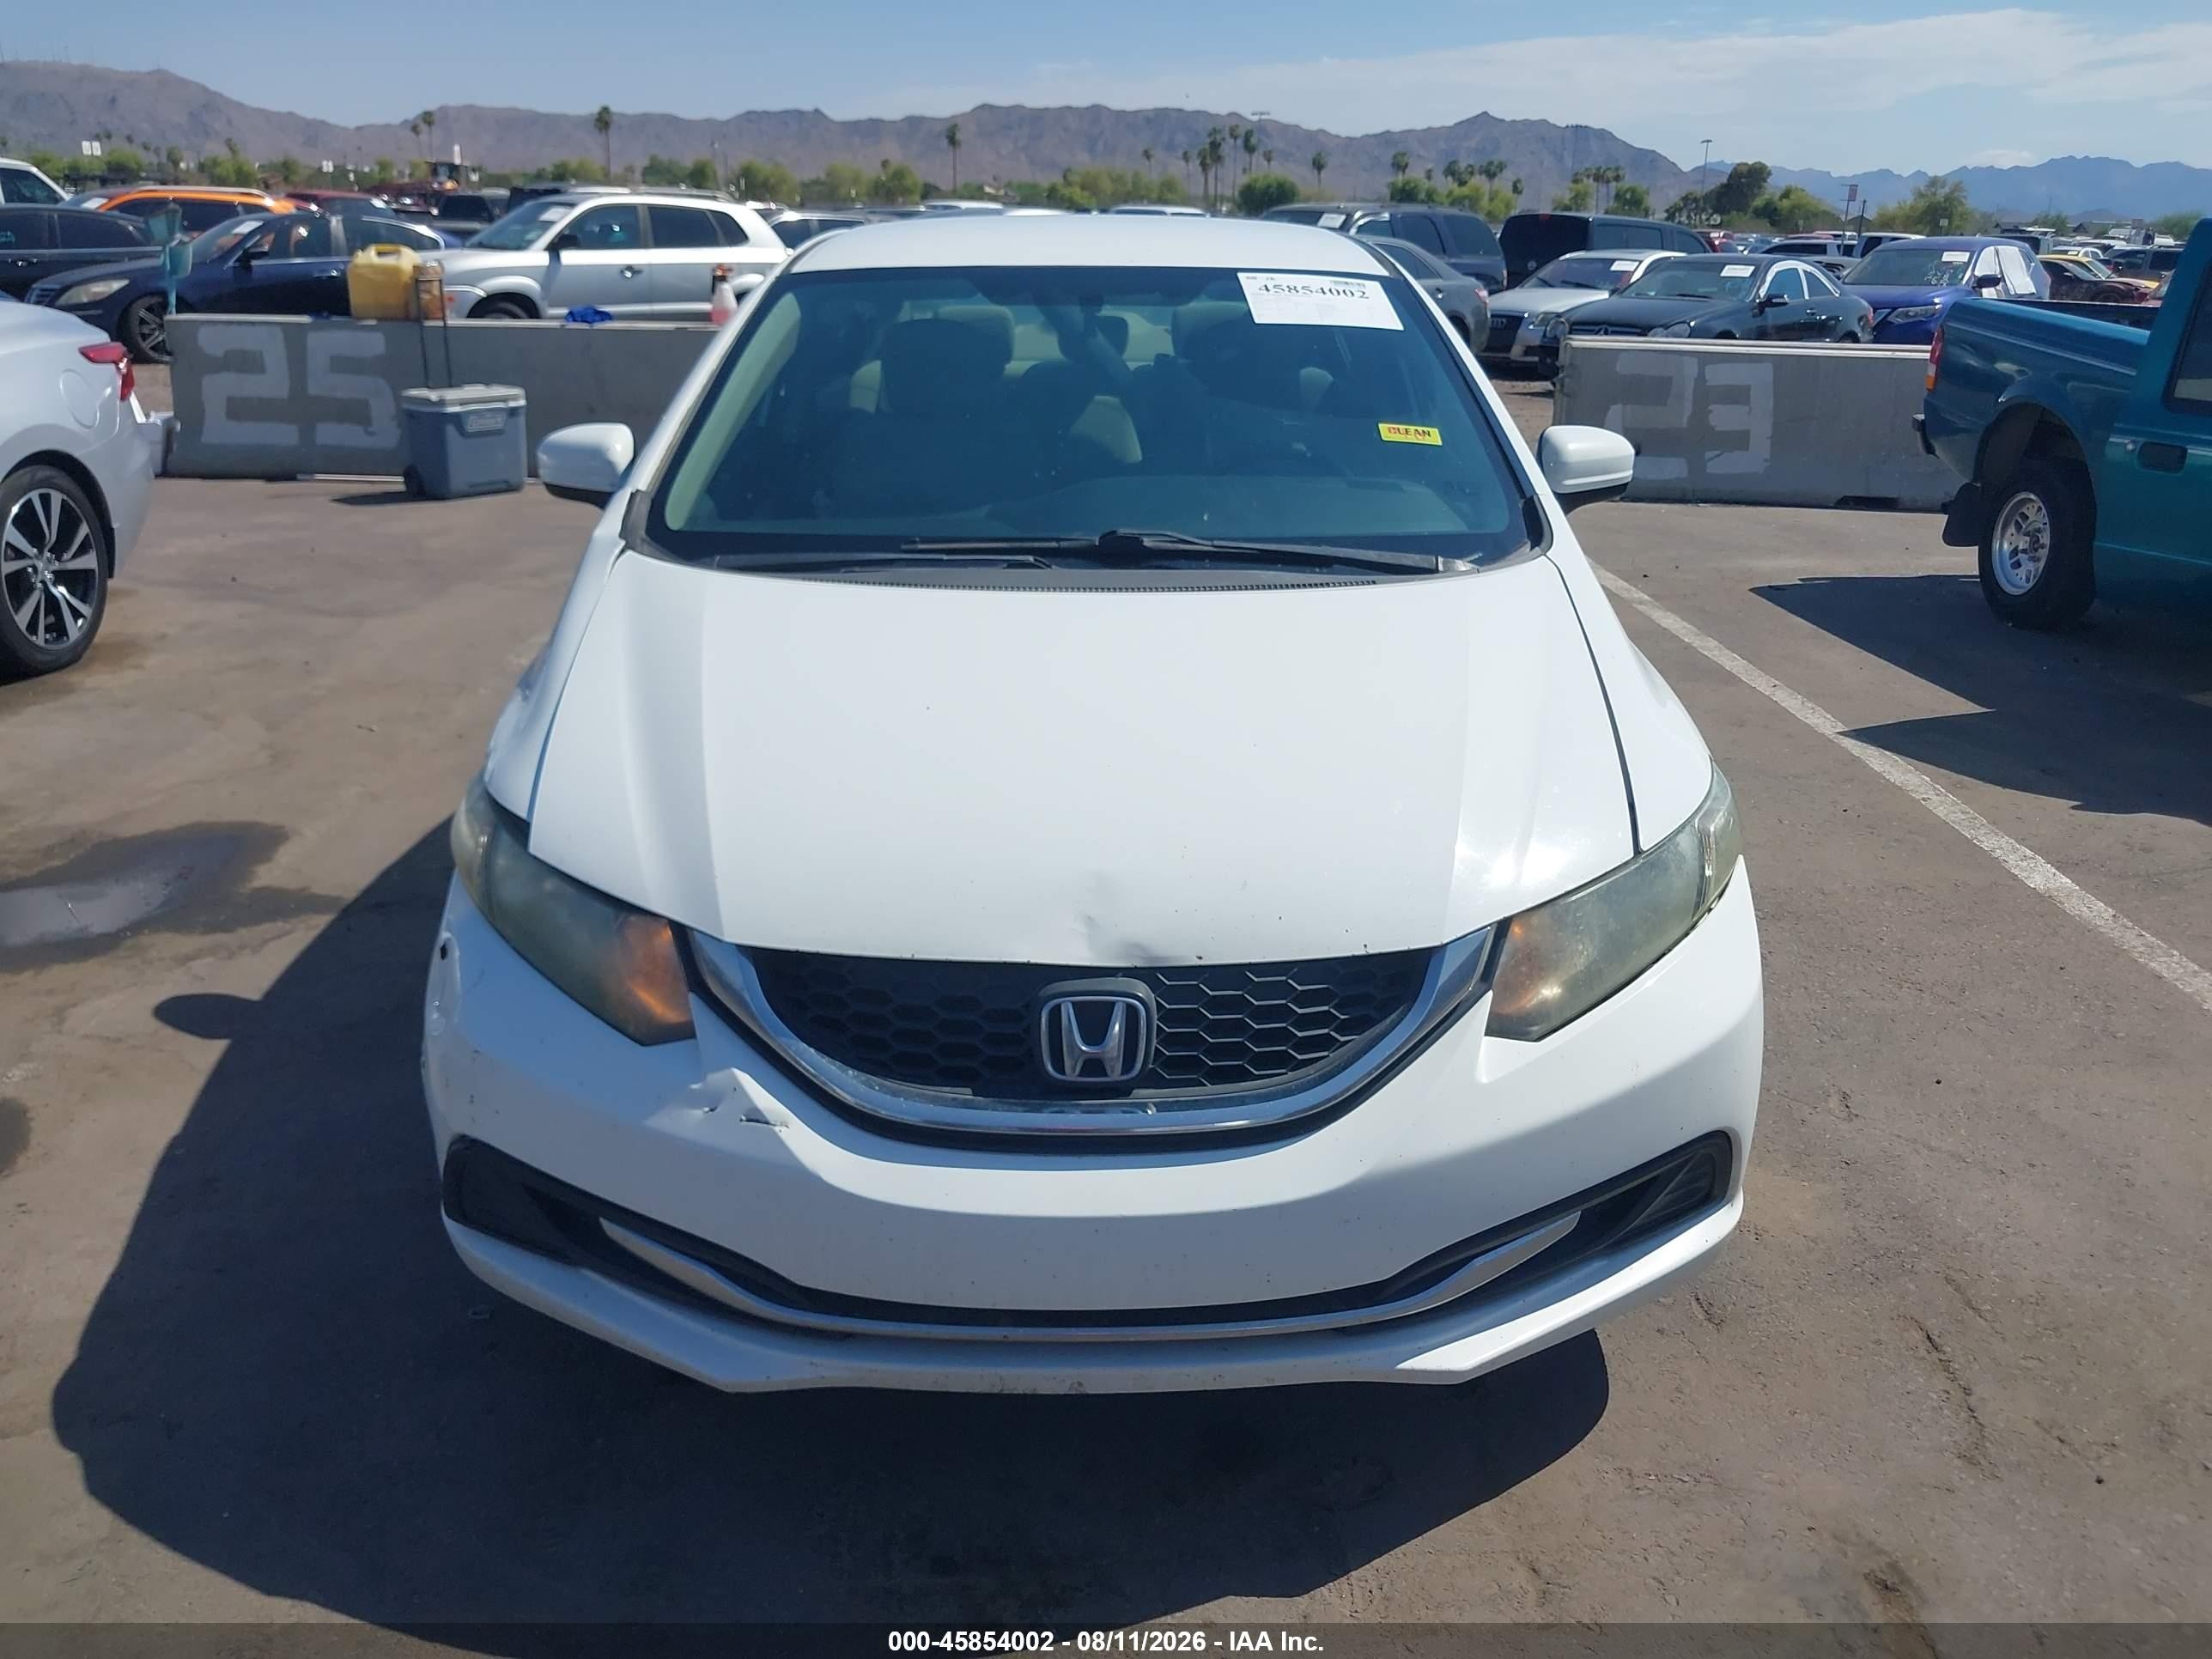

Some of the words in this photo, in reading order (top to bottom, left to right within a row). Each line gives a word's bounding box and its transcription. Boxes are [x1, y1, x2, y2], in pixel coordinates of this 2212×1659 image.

[1258, 283, 1370, 300] 45854002
[198, 324, 401, 449] 25
[1603, 350, 1774, 481] 23
[1387, 426, 1431, 438] CLEAN
